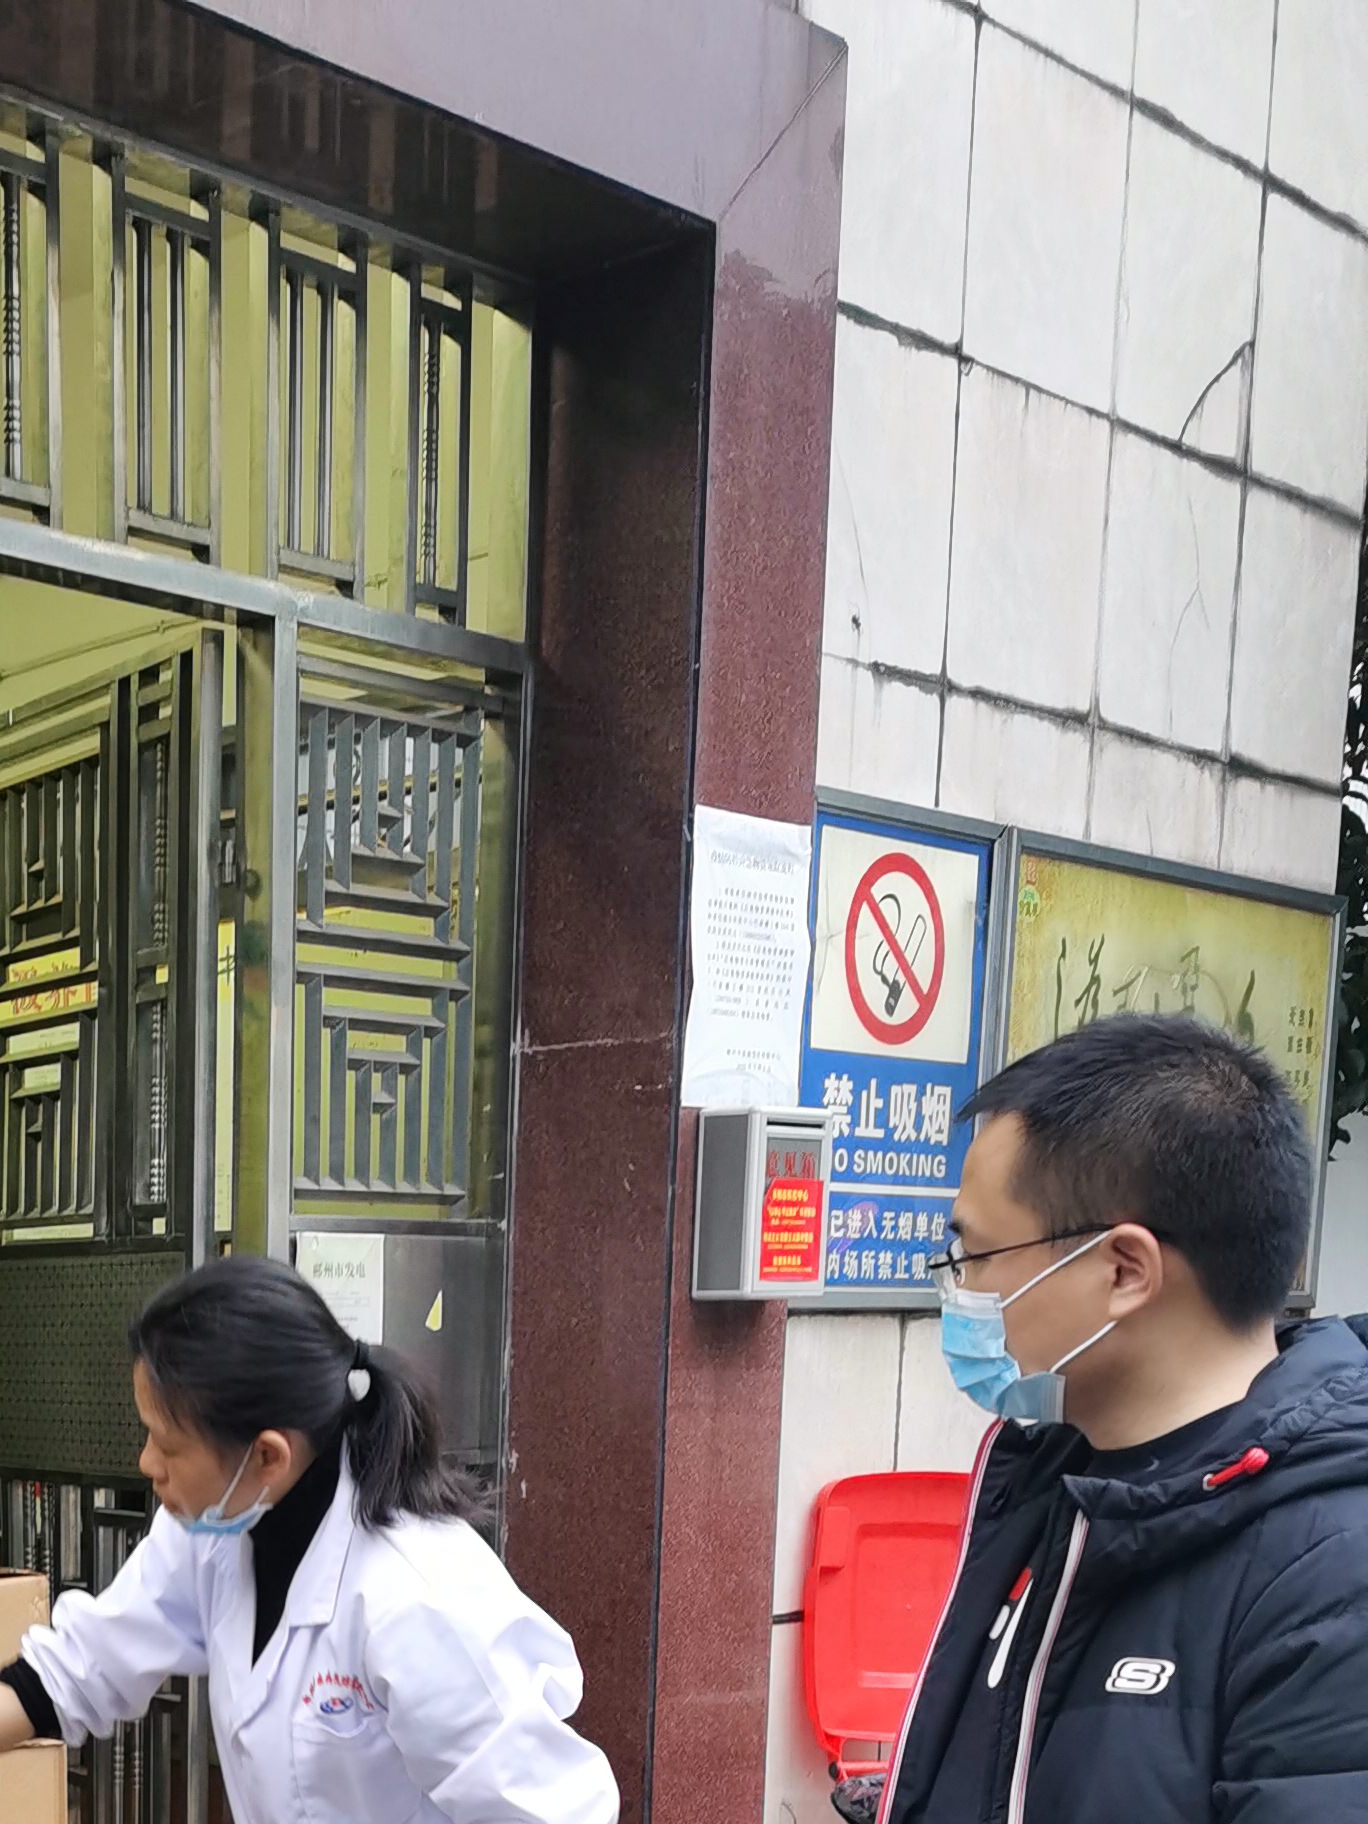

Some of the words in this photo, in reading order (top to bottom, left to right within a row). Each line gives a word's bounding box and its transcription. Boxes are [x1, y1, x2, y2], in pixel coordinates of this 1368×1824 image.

[822, 1072, 953, 1146] 禁止吸烟
[834, 1148, 849, 1173] O
[853, 1150, 947, 1178] SMOKING
[831, 1209, 947, 1242] 已进入无烟单位
[826, 1250, 934, 1281] 内场所禁止吸
